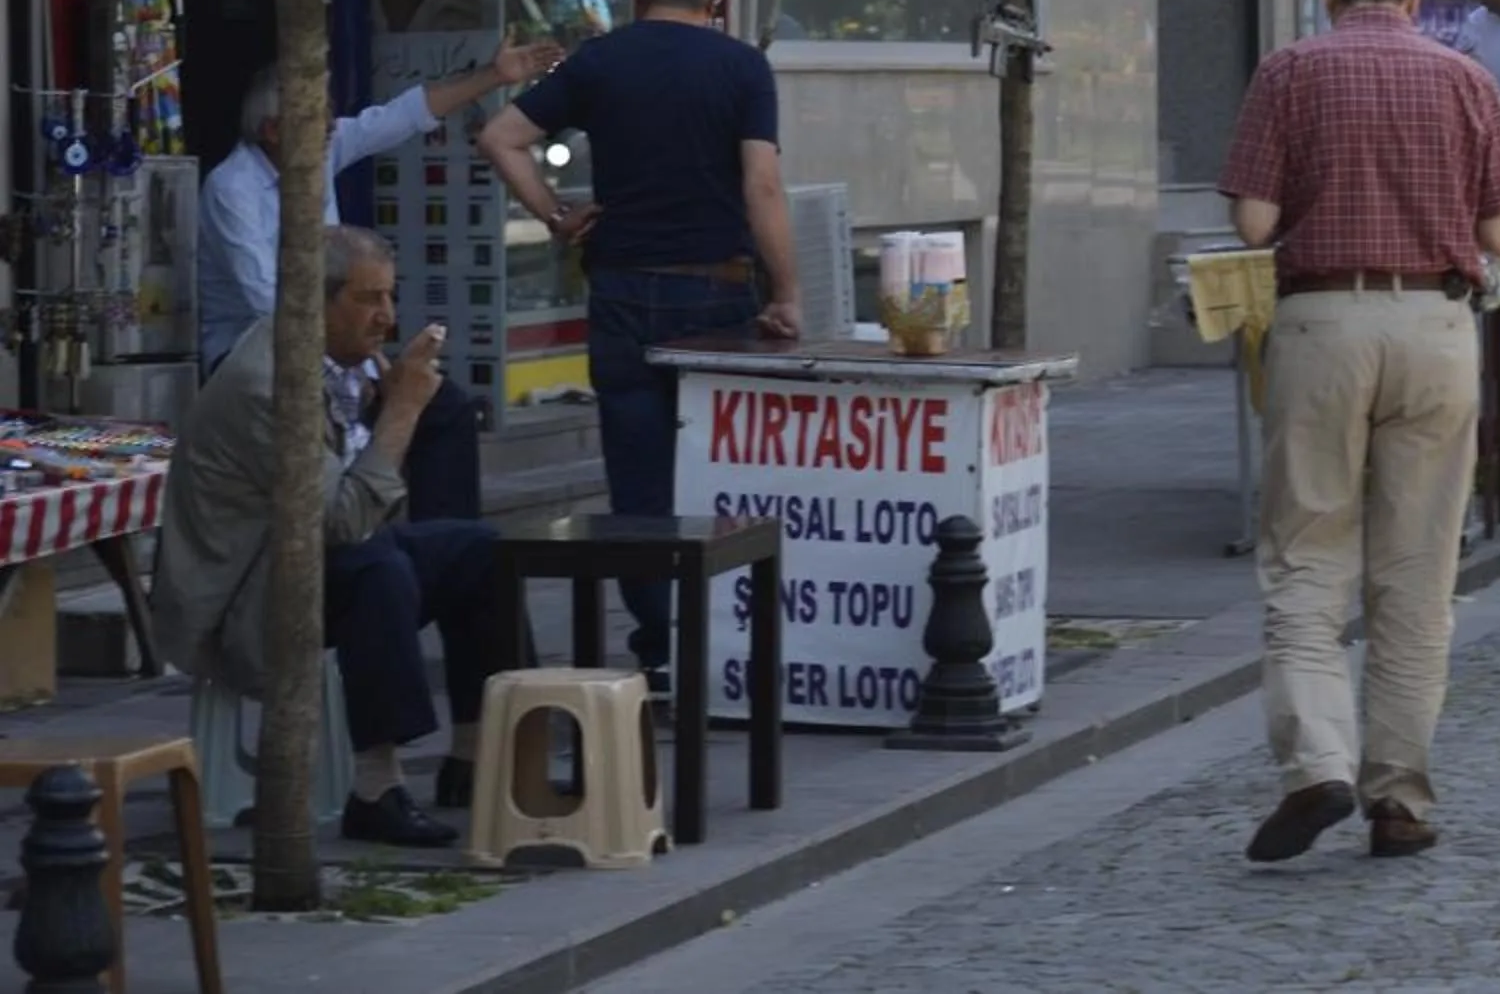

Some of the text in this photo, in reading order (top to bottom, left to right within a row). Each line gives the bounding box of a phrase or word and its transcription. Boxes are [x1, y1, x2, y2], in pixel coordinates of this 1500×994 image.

[855, 499, 938, 547] LOTO
[732, 575, 914, 633] ŞNS TOPU
[723, 658, 920, 712] SER LOTO
